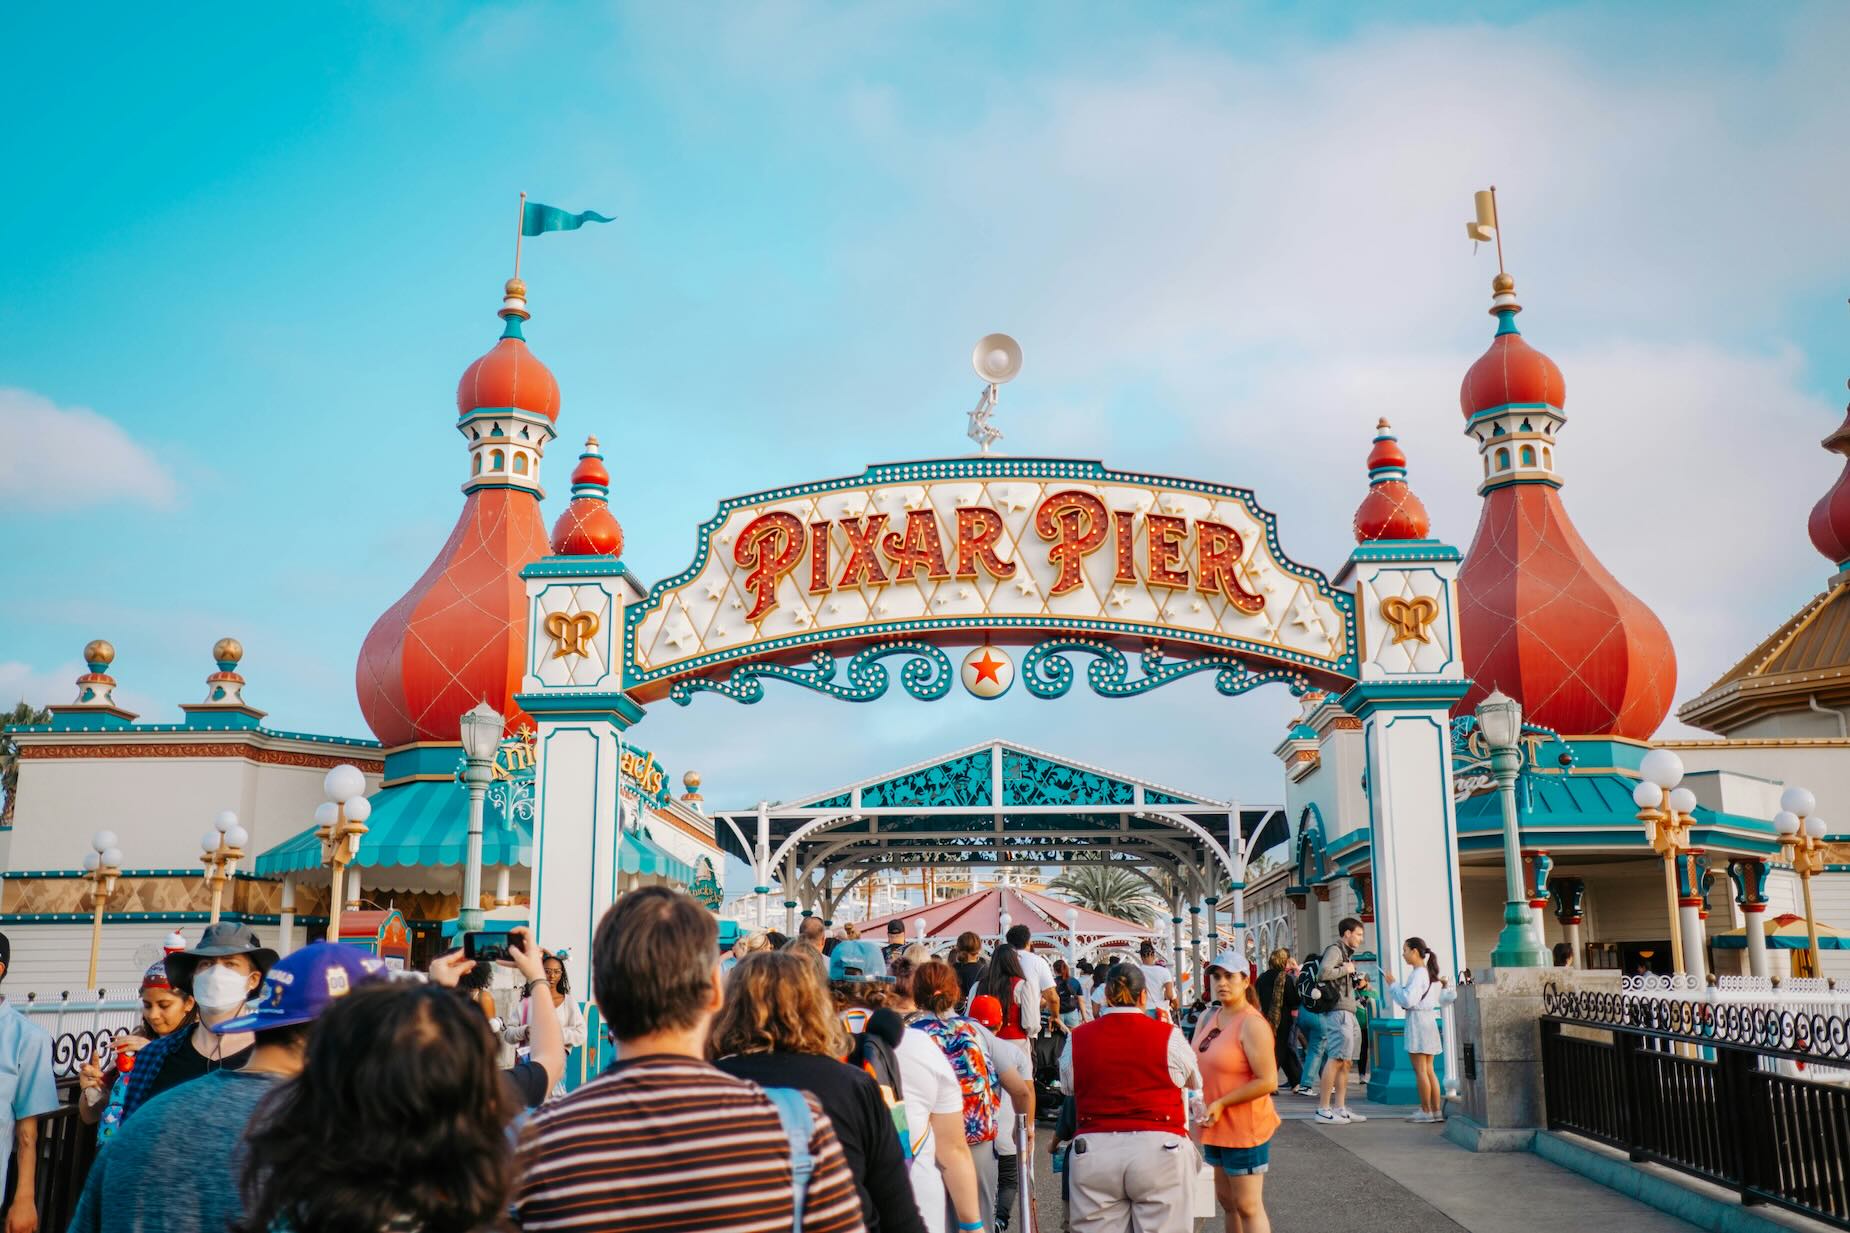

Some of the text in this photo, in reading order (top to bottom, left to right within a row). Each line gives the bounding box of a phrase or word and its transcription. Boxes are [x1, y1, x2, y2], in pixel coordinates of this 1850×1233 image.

[733, 490, 1266, 622] PIXAR PIER
[621, 751, 663, 794] acks
